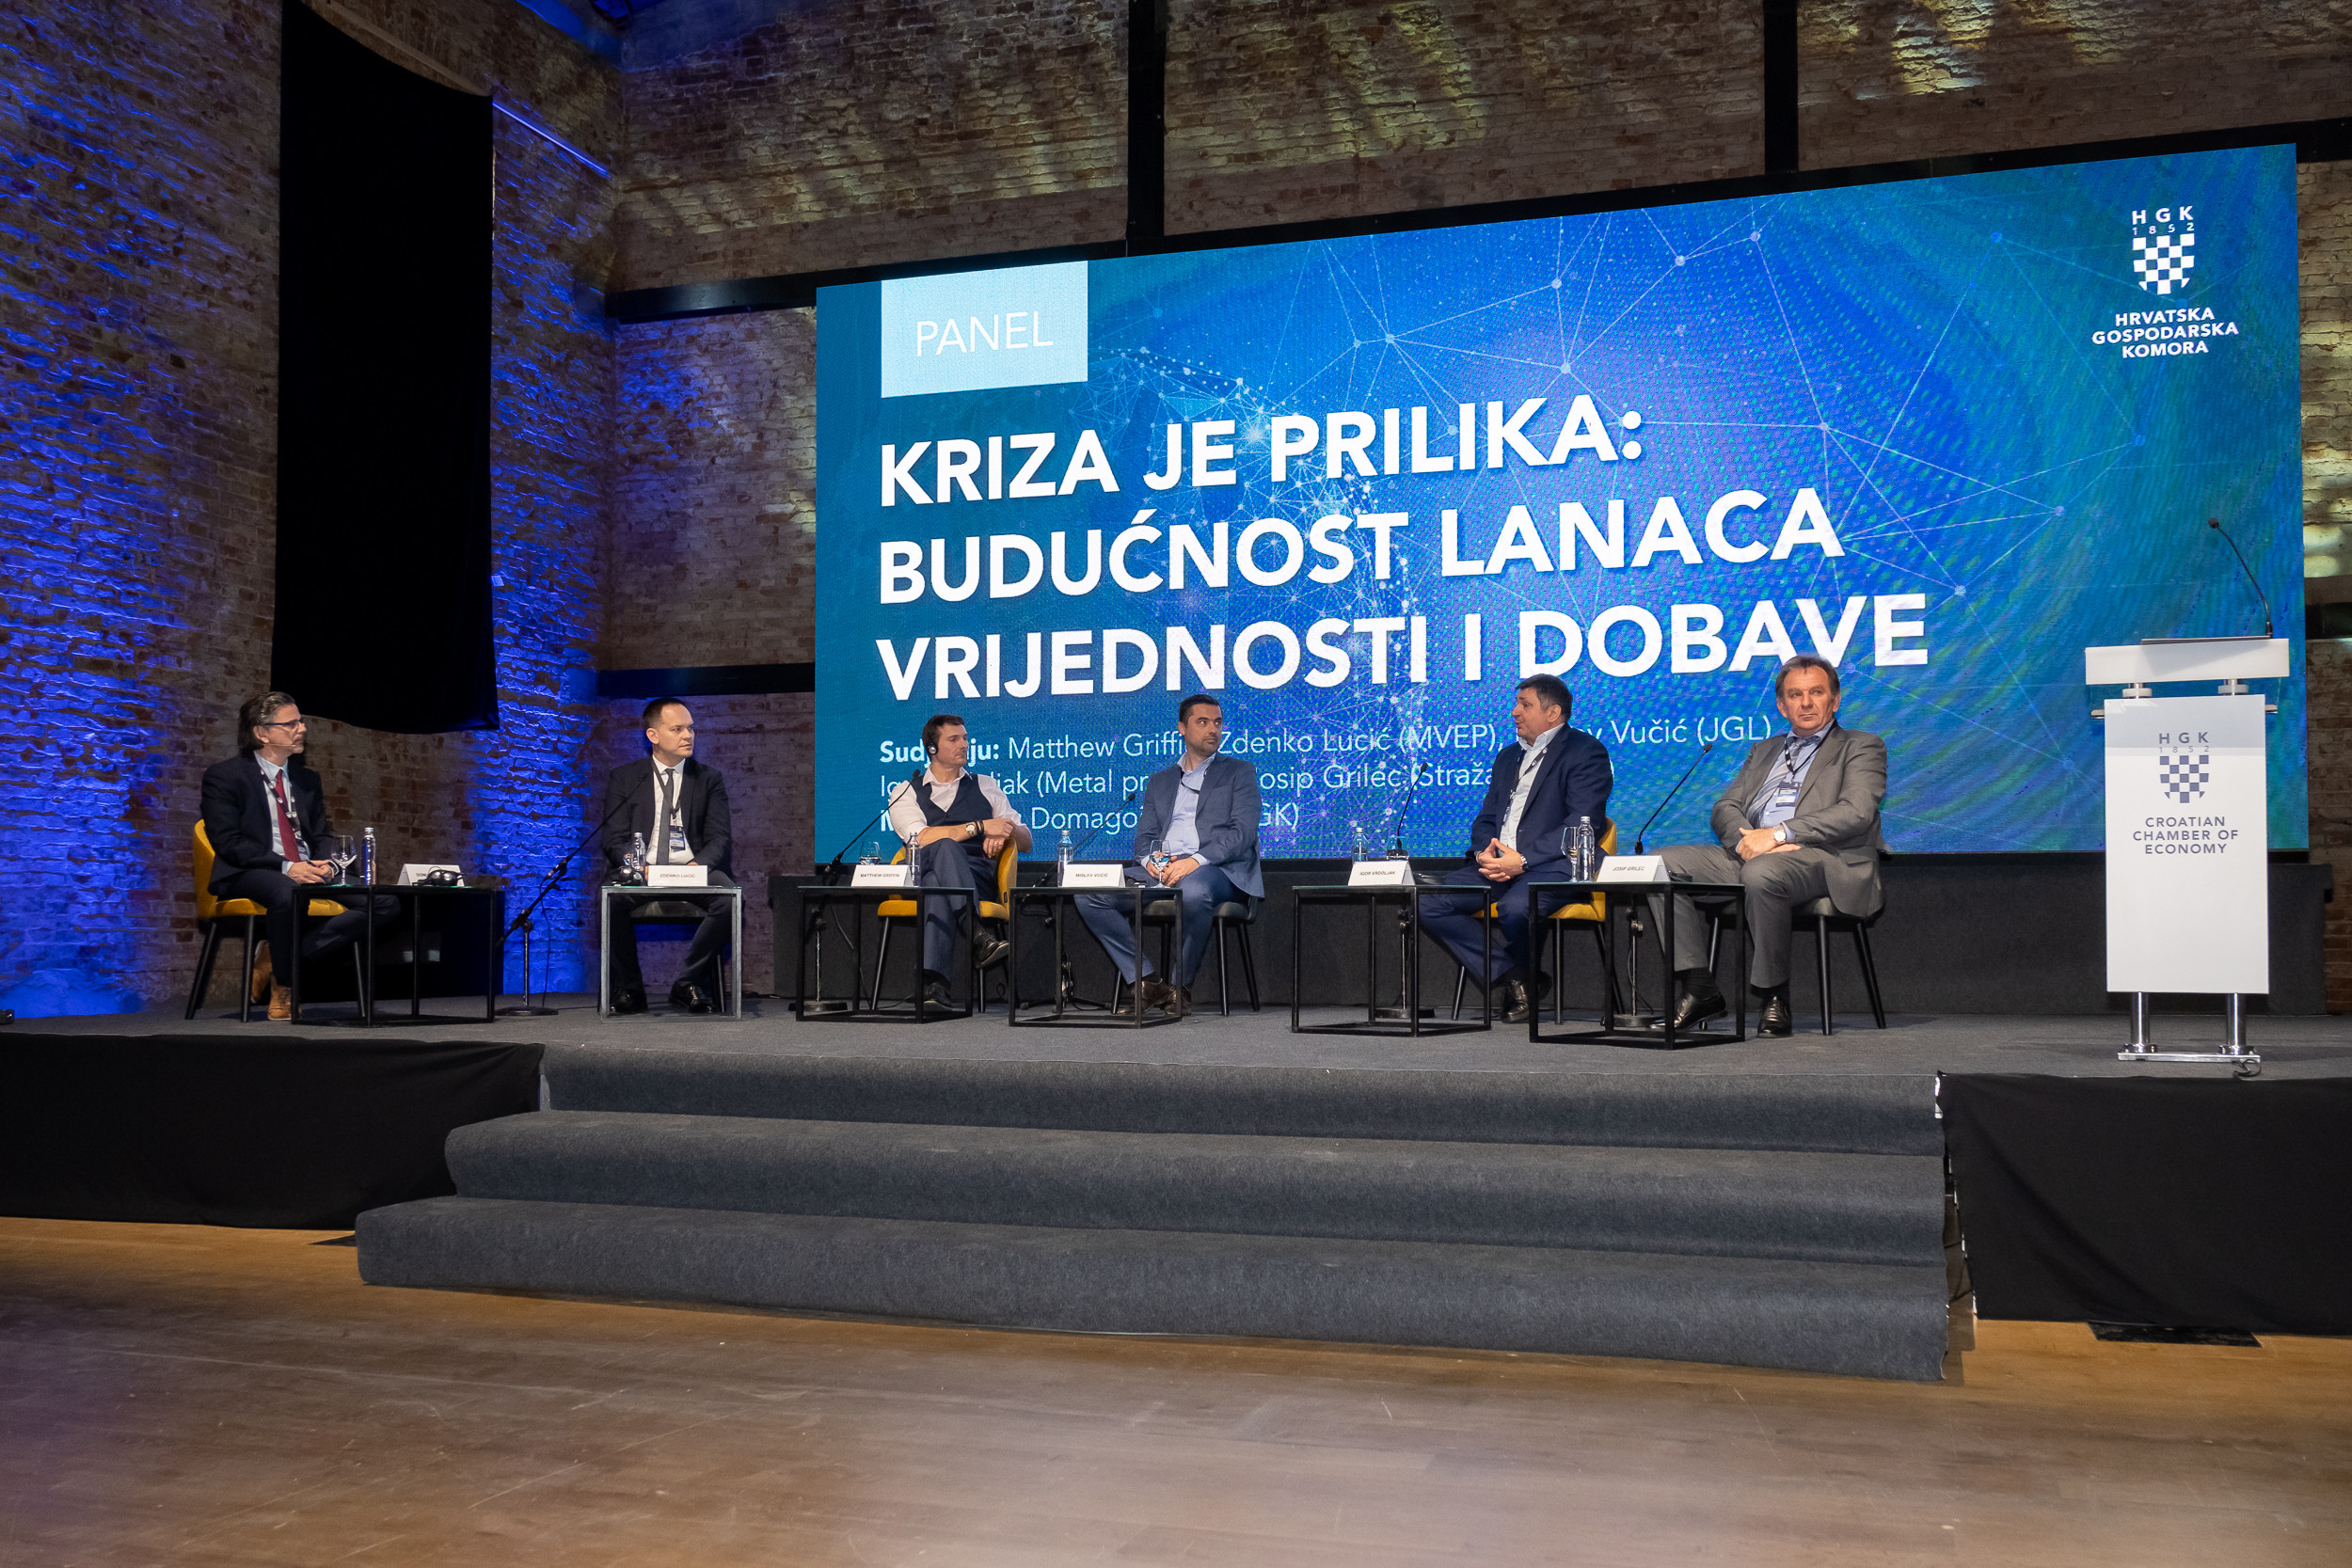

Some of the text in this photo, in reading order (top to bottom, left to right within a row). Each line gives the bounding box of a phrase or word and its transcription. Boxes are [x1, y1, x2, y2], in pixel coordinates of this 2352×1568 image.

[2115, 307, 2215, 327] HRVATSKA
[915, 310, 1054, 356] PANEL
[2091, 322, 2239, 345] GOSPODARSKA
[2122, 341, 2209, 358] KOMORA
[881, 394, 1643, 507] KRIZA JE PRILIKA:
[880, 487, 1845, 605] BUDUĆNOST LANACA
[875, 593, 1929, 702] VRIJEDNOSTI I DOBAVE
[1009, 735, 1116, 759] Matthew
[1217, 727, 1313, 753] Zdenko
[1611, 718, 1689, 744] Vučić
[1697, 715, 1772, 746] (JGL)
[1037, 768, 1112, 798] (Metal
[1255, 766, 1313, 798] osip
[1031, 805, 1143, 835] Domago
[2145, 816, 2225, 828] CROATIAN
[2133, 830, 2239, 841] CHAMBER OF
[2145, 844, 2227, 854] ECONOMY
